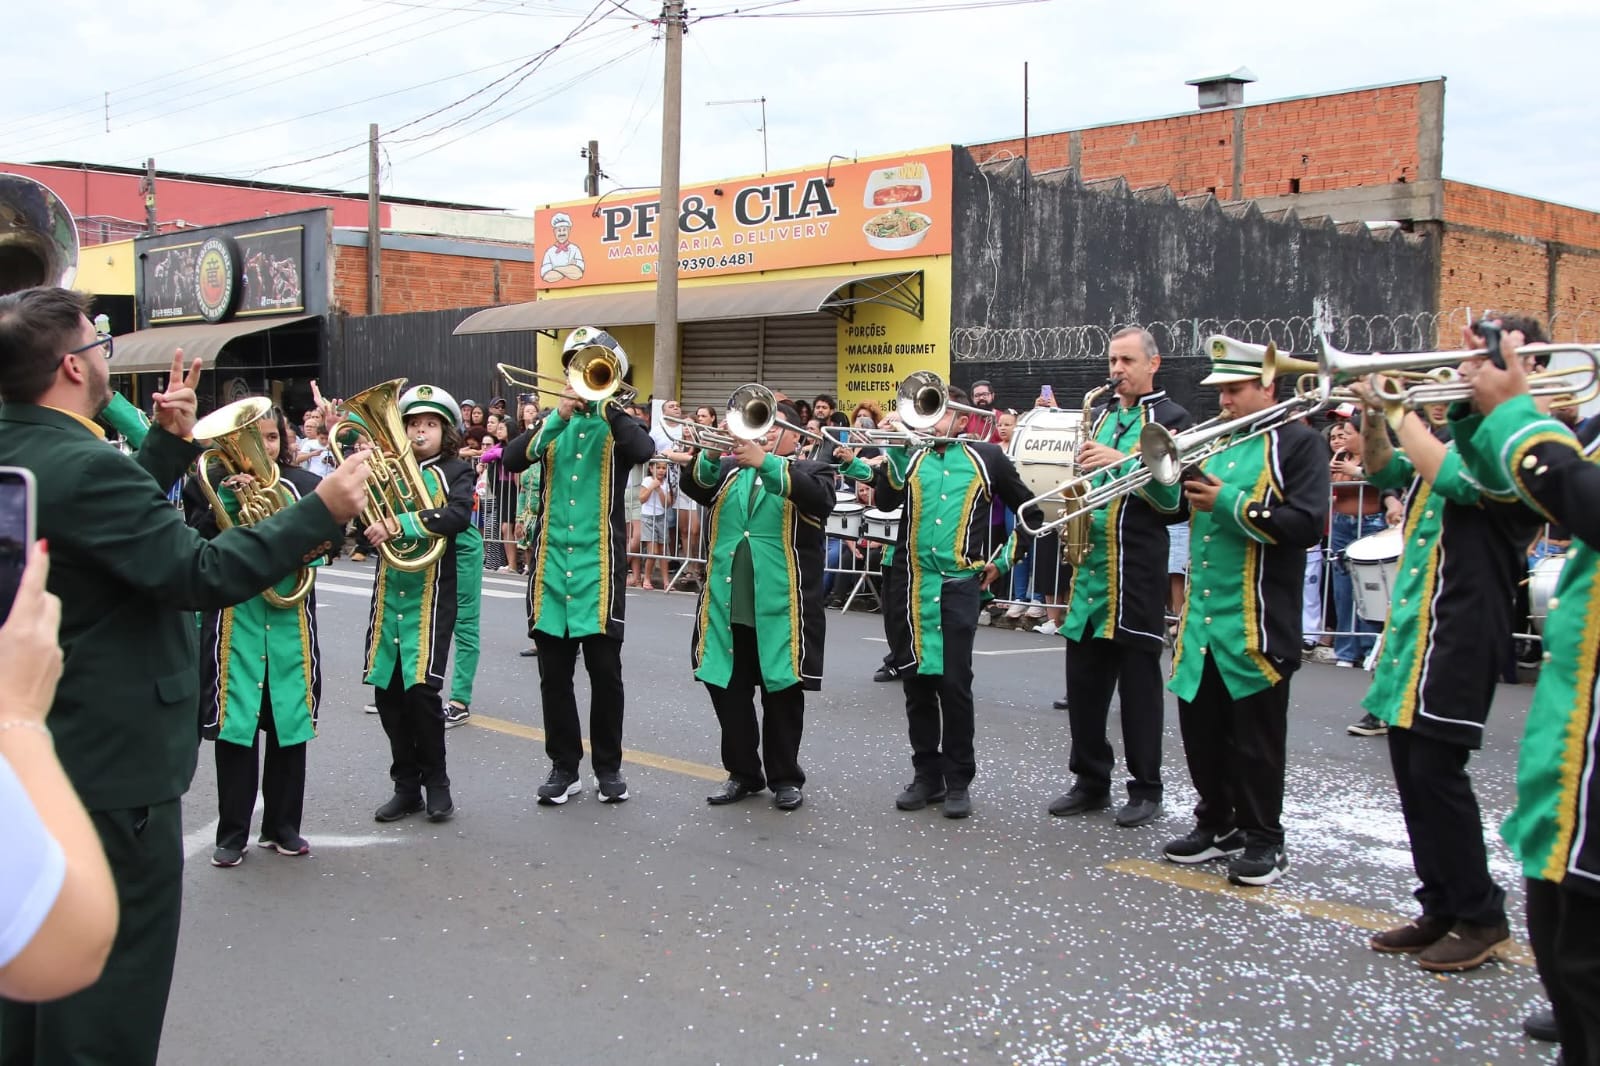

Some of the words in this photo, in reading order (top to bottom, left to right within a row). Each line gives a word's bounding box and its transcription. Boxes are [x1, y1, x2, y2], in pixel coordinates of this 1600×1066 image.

[602, 202, 661, 242] PF
[678, 196, 717, 233] &
[735, 178, 837, 226] CIA
[608, 236, 722, 259] MARMARIA
[734, 223, 829, 244] DELIVERY
[848, 323, 886, 338] PORÇÕES
[848, 342, 893, 355] MACARRÃO
[895, 344, 936, 354] GOURMET
[848, 363, 894, 374] YAKISOBA
[848, 380, 890, 391] OMELETES
[1024, 439, 1075, 452] CAPTAIN
